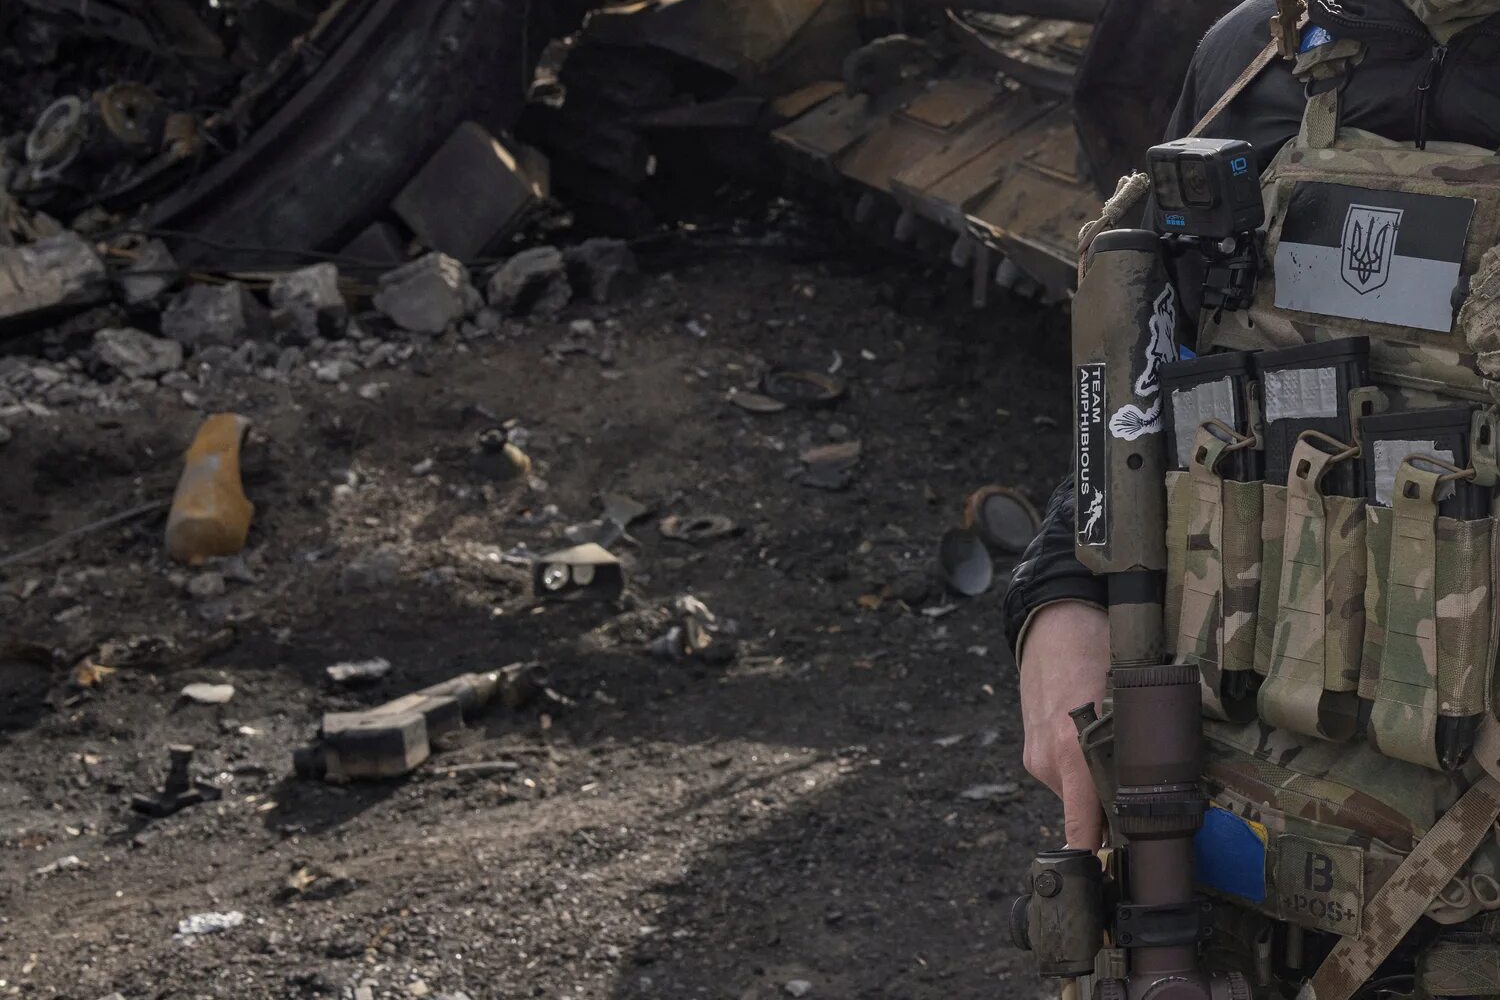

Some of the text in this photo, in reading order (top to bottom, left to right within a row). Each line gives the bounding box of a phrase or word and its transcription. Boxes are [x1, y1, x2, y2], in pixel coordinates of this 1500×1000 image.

[1230, 157, 1247, 172] 10
[1092, 367, 1101, 423] TEAM
[1080, 369, 1090, 495] AMPHIBIOUS
[1304, 851, 1334, 893] B
